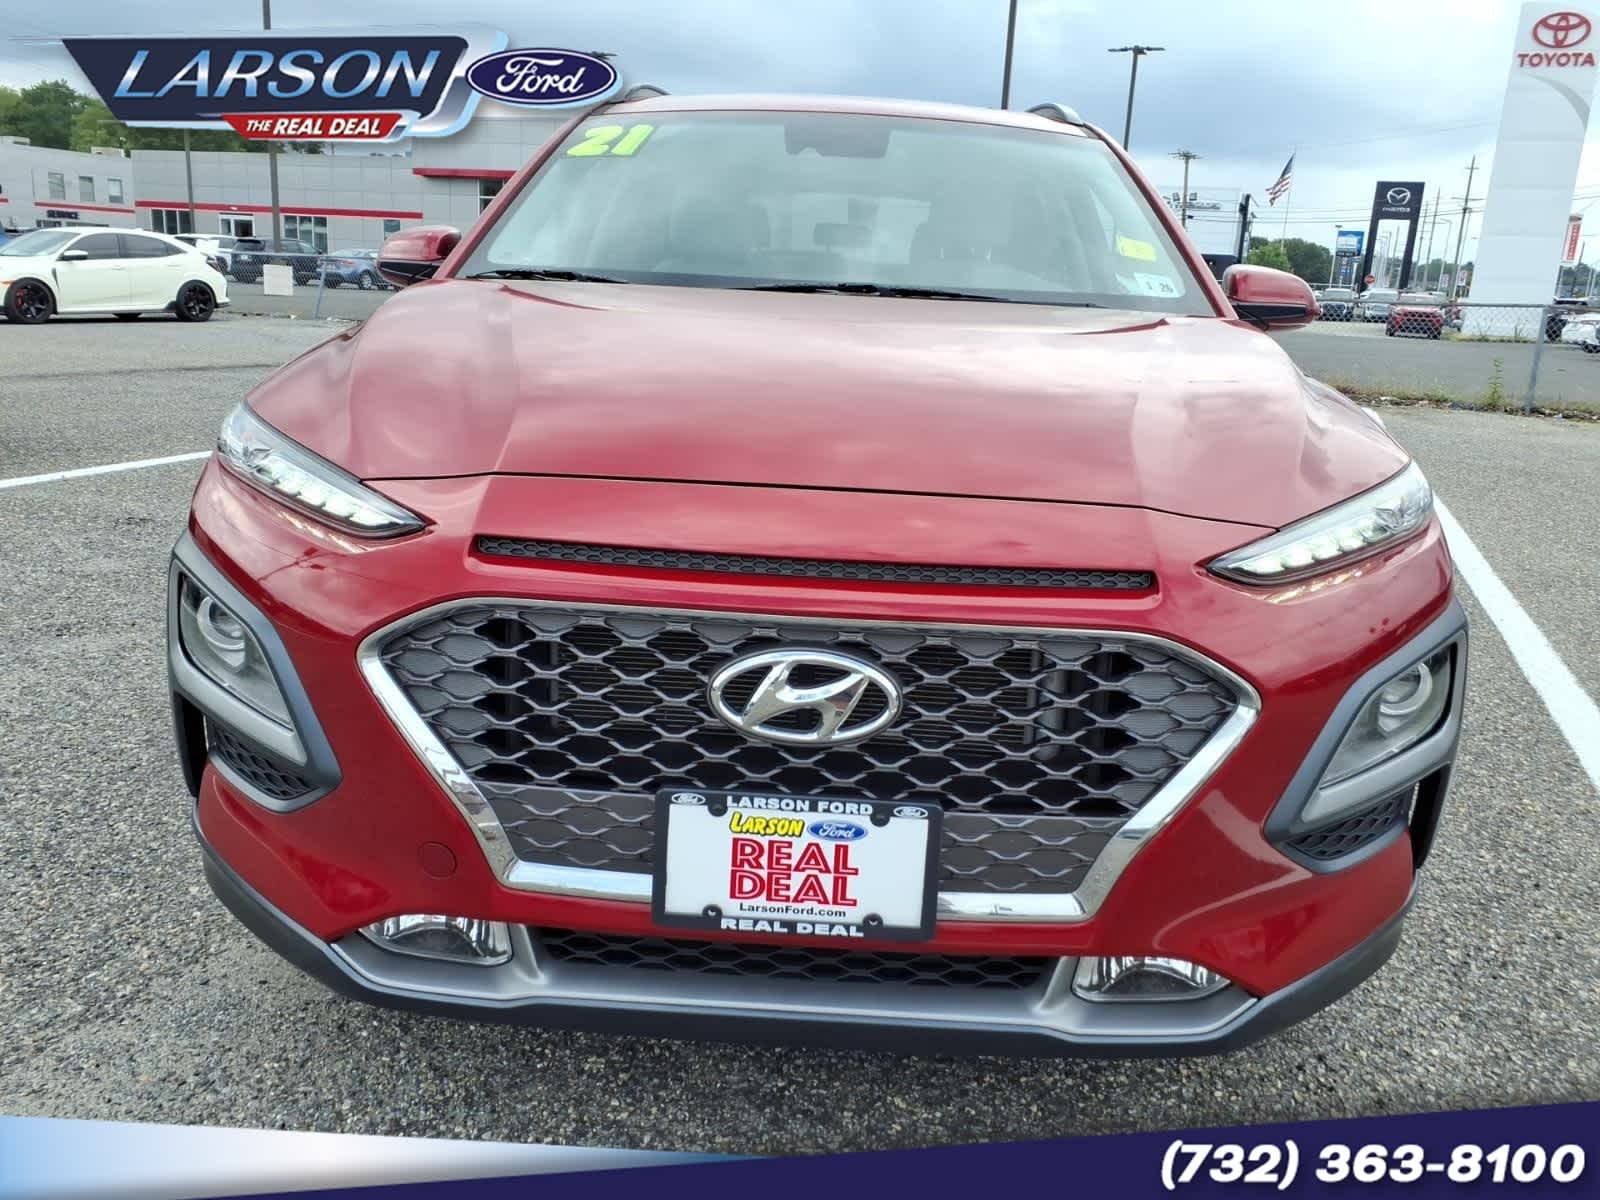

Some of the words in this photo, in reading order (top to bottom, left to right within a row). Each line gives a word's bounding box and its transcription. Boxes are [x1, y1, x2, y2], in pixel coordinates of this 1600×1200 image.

[1518, 52, 1595, 67] TOYOTA
[566, 124, 654, 157] 21
[726, 795, 809, 812] LARSON
[817, 801, 873, 816] FORD
[819, 821, 856, 839] Ford
[731, 837, 860, 876] REAL
[729, 868, 858, 907] DEAL
[739, 902, 847, 918] LarsonFord.com
[720, 917, 788, 933] REAL
[796, 922, 865, 938] DEAL
